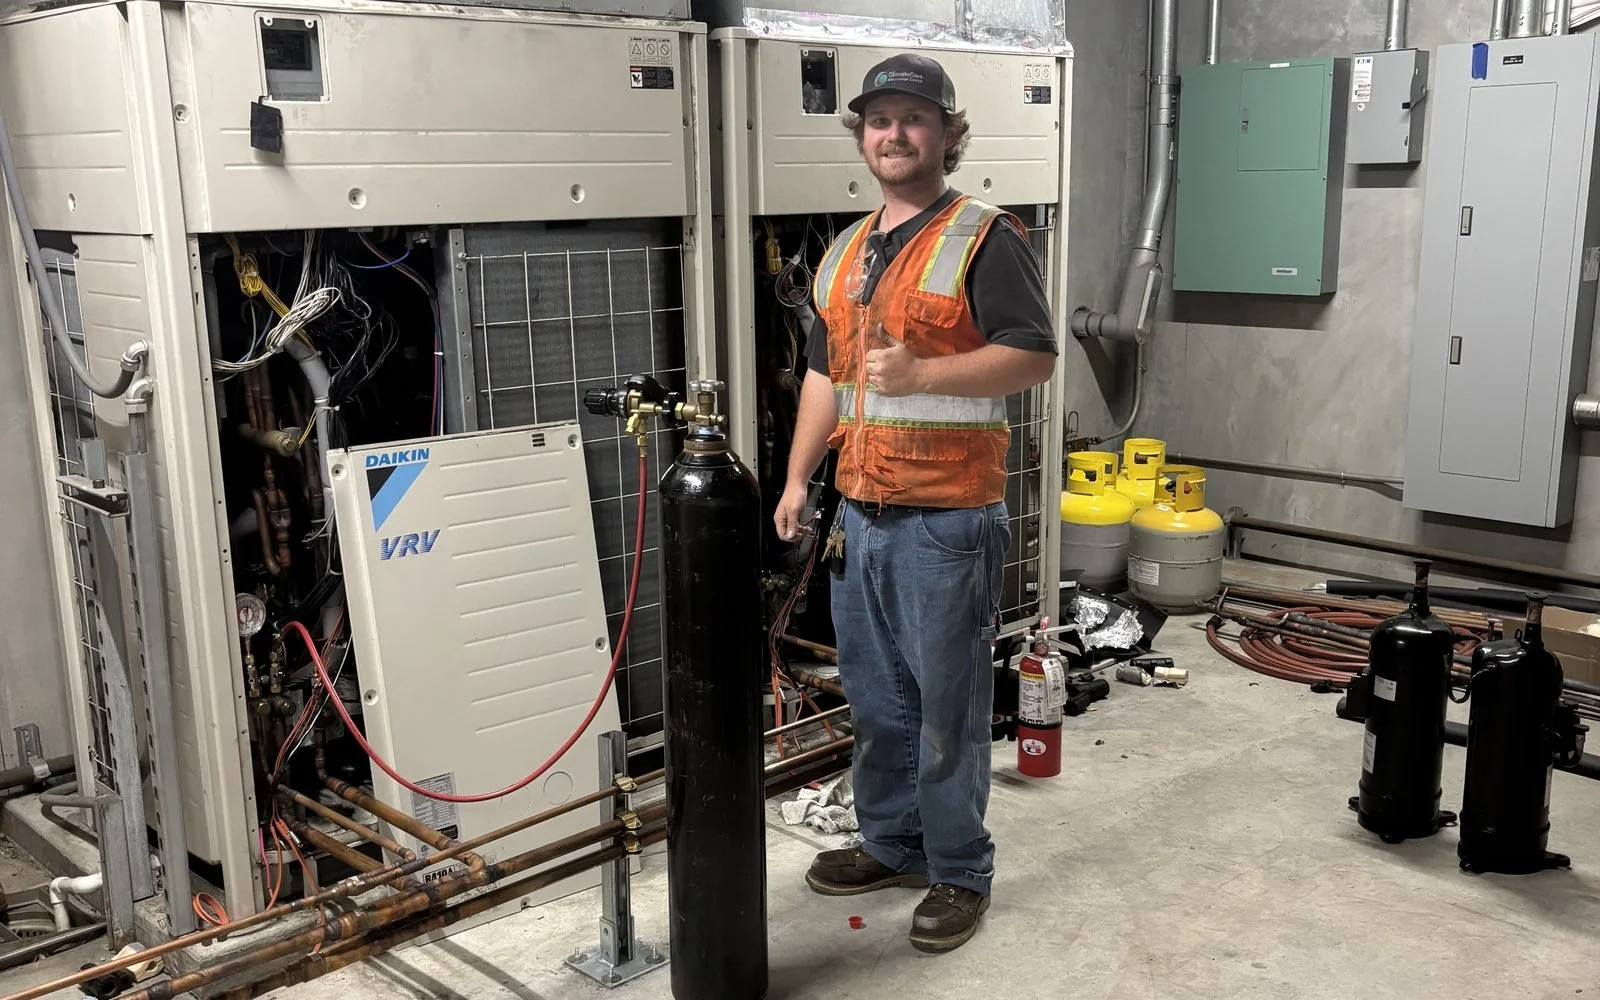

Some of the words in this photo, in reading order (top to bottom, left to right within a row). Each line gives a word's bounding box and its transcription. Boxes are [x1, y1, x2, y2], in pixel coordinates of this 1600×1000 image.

[365, 447, 430, 468] DAIKIN
[380, 529, 441, 561] VRV
[424, 867, 454, 883] R410A
